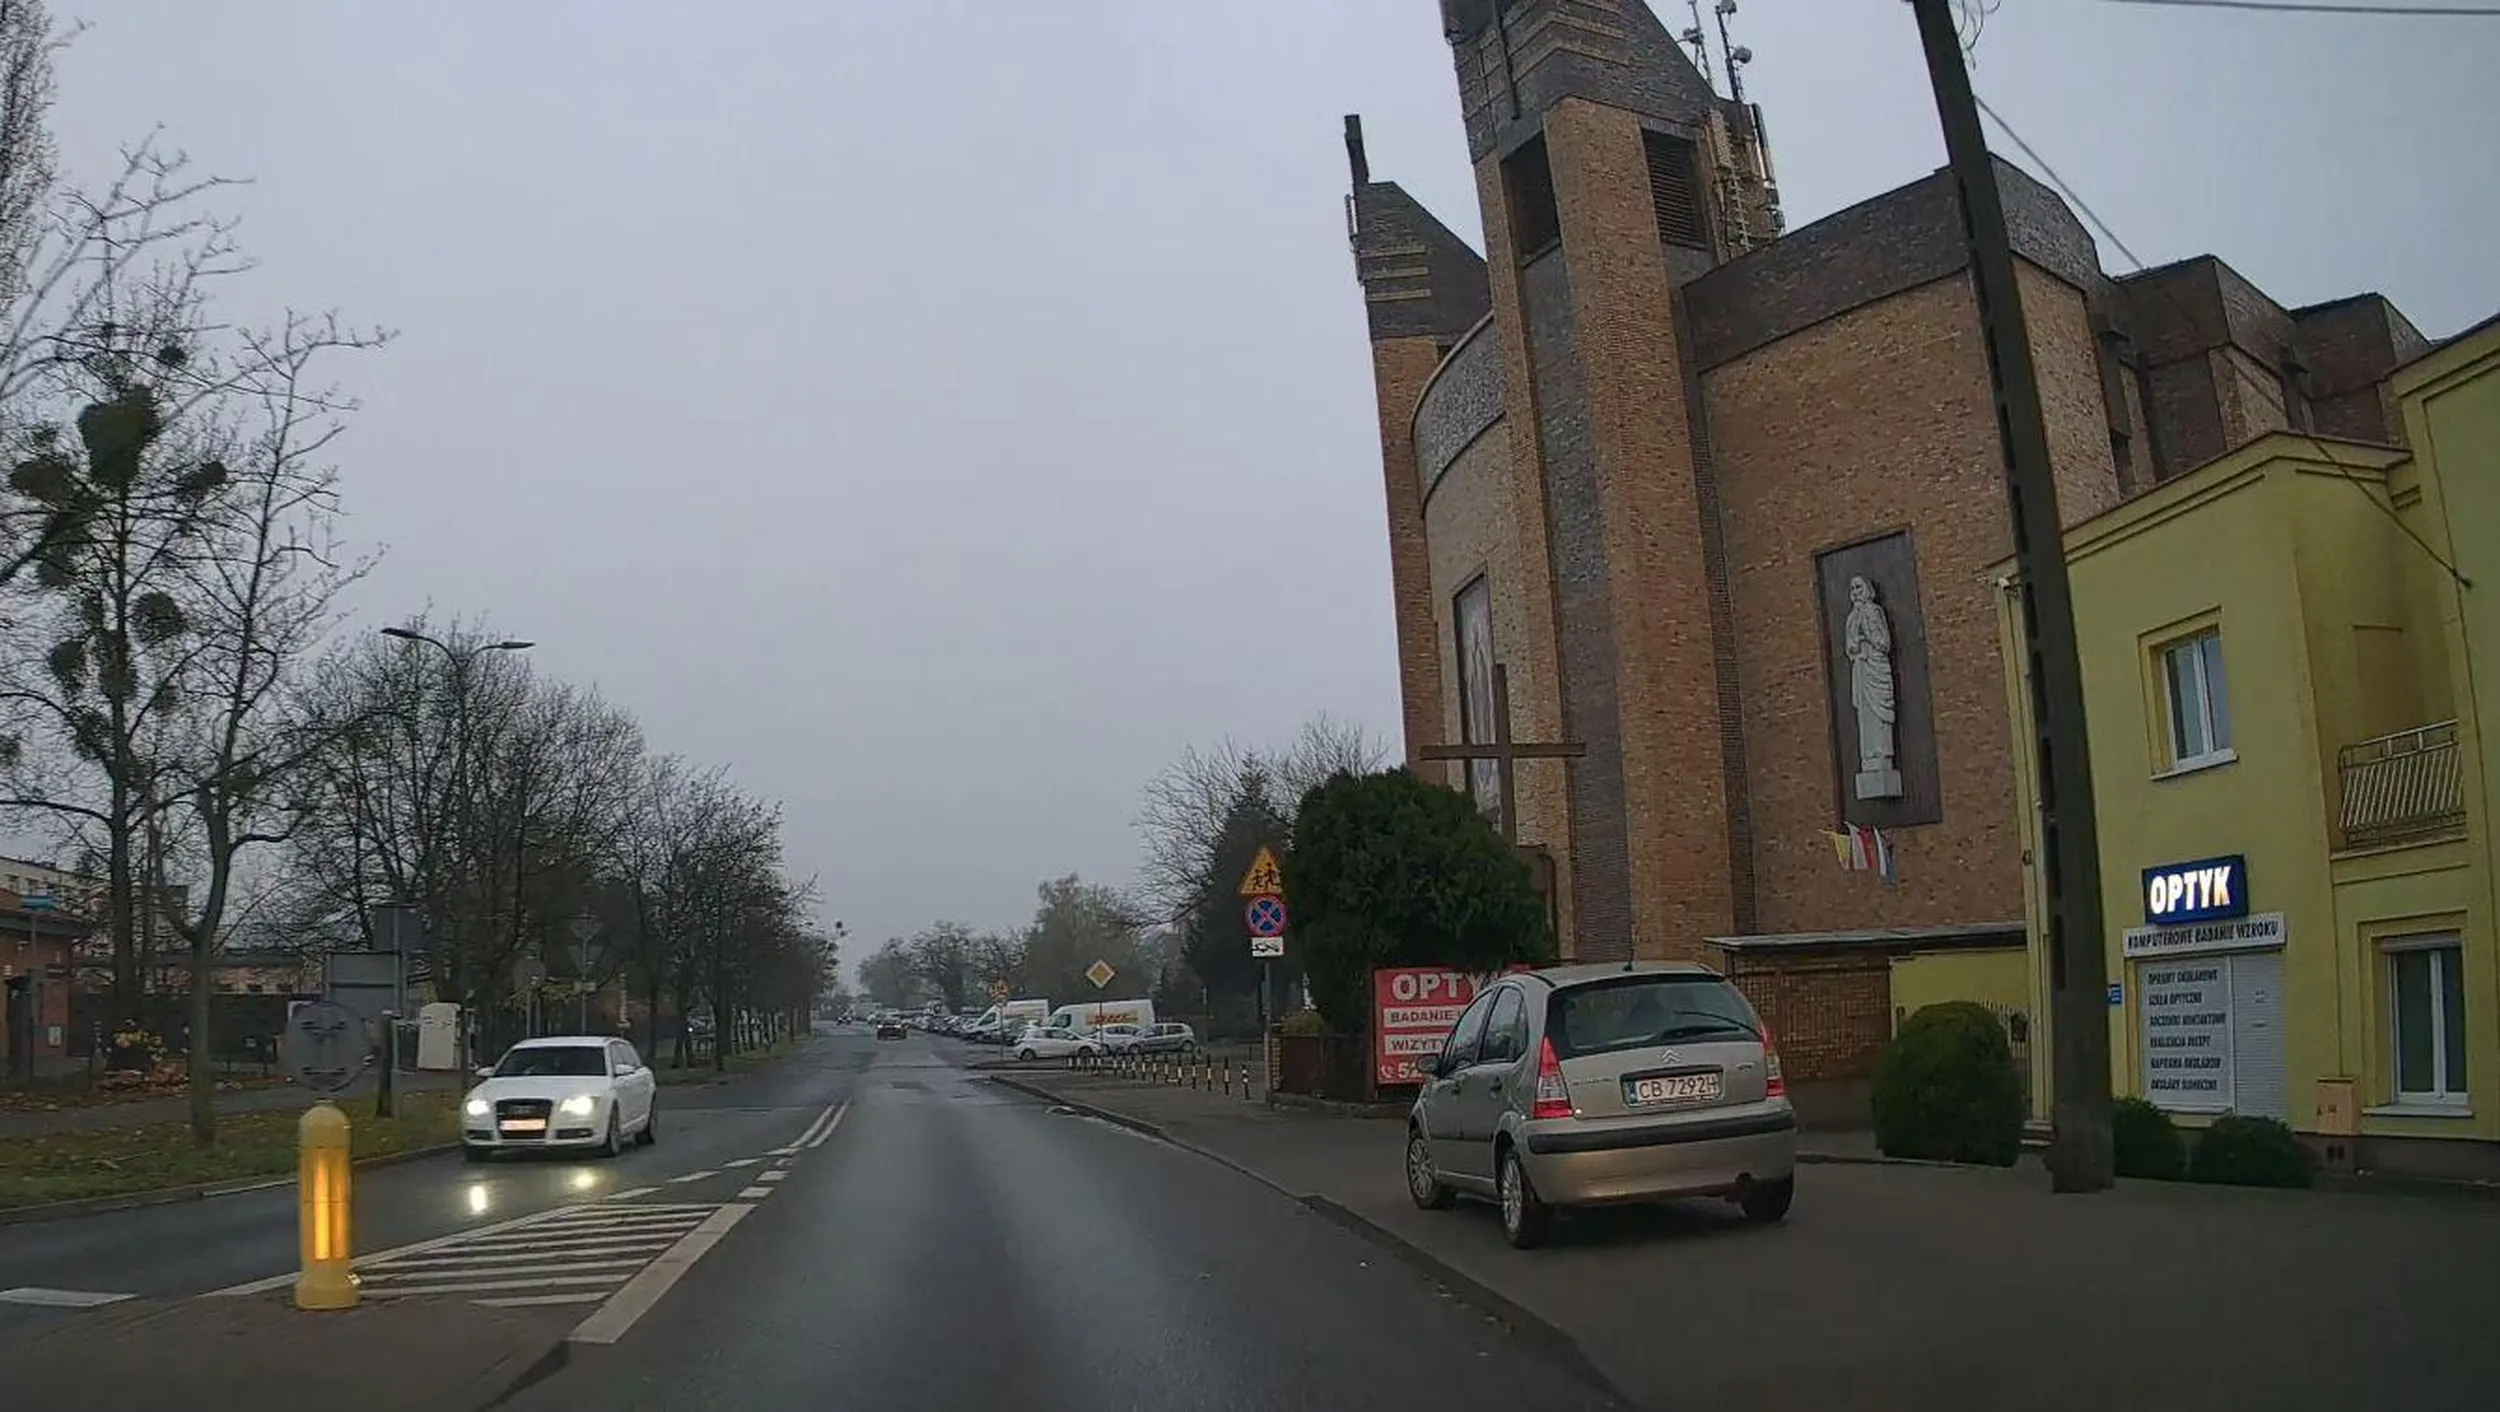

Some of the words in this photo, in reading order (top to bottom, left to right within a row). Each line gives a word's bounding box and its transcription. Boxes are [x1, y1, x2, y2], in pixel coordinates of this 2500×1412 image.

[2150, 865, 2232, 915] OPTYK
[2128, 928, 2193, 949] KOMPUTEROWE
[2194, 924, 2234, 943] BADANIE
[2236, 921, 2279, 939] WZROKU
[1390, 1009, 1456, 1023] BADANIE
[1639, 1081, 1663, 1098] CB
[1667, 1075, 1717, 1096] 7292H
